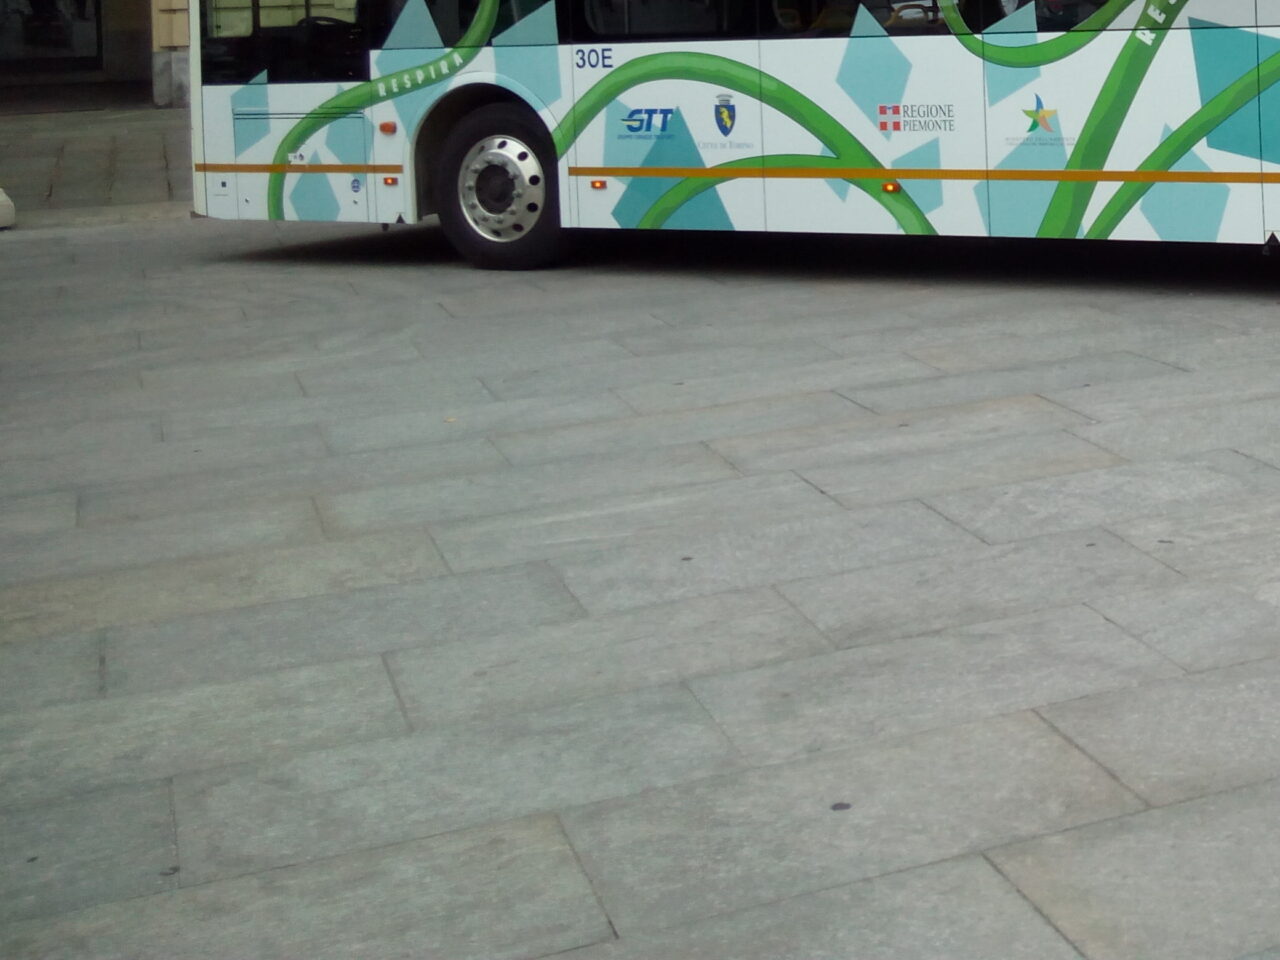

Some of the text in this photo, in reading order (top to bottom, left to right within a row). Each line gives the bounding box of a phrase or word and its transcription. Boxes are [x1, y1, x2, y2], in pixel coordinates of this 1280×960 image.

[575, 48, 614, 69] 30E
[377, 51, 464, 97] RESPIRA
[621, 108, 674, 133] GTT
[902, 104, 955, 119] REGIONE
[902, 120, 956, 132] PIEMONTE
